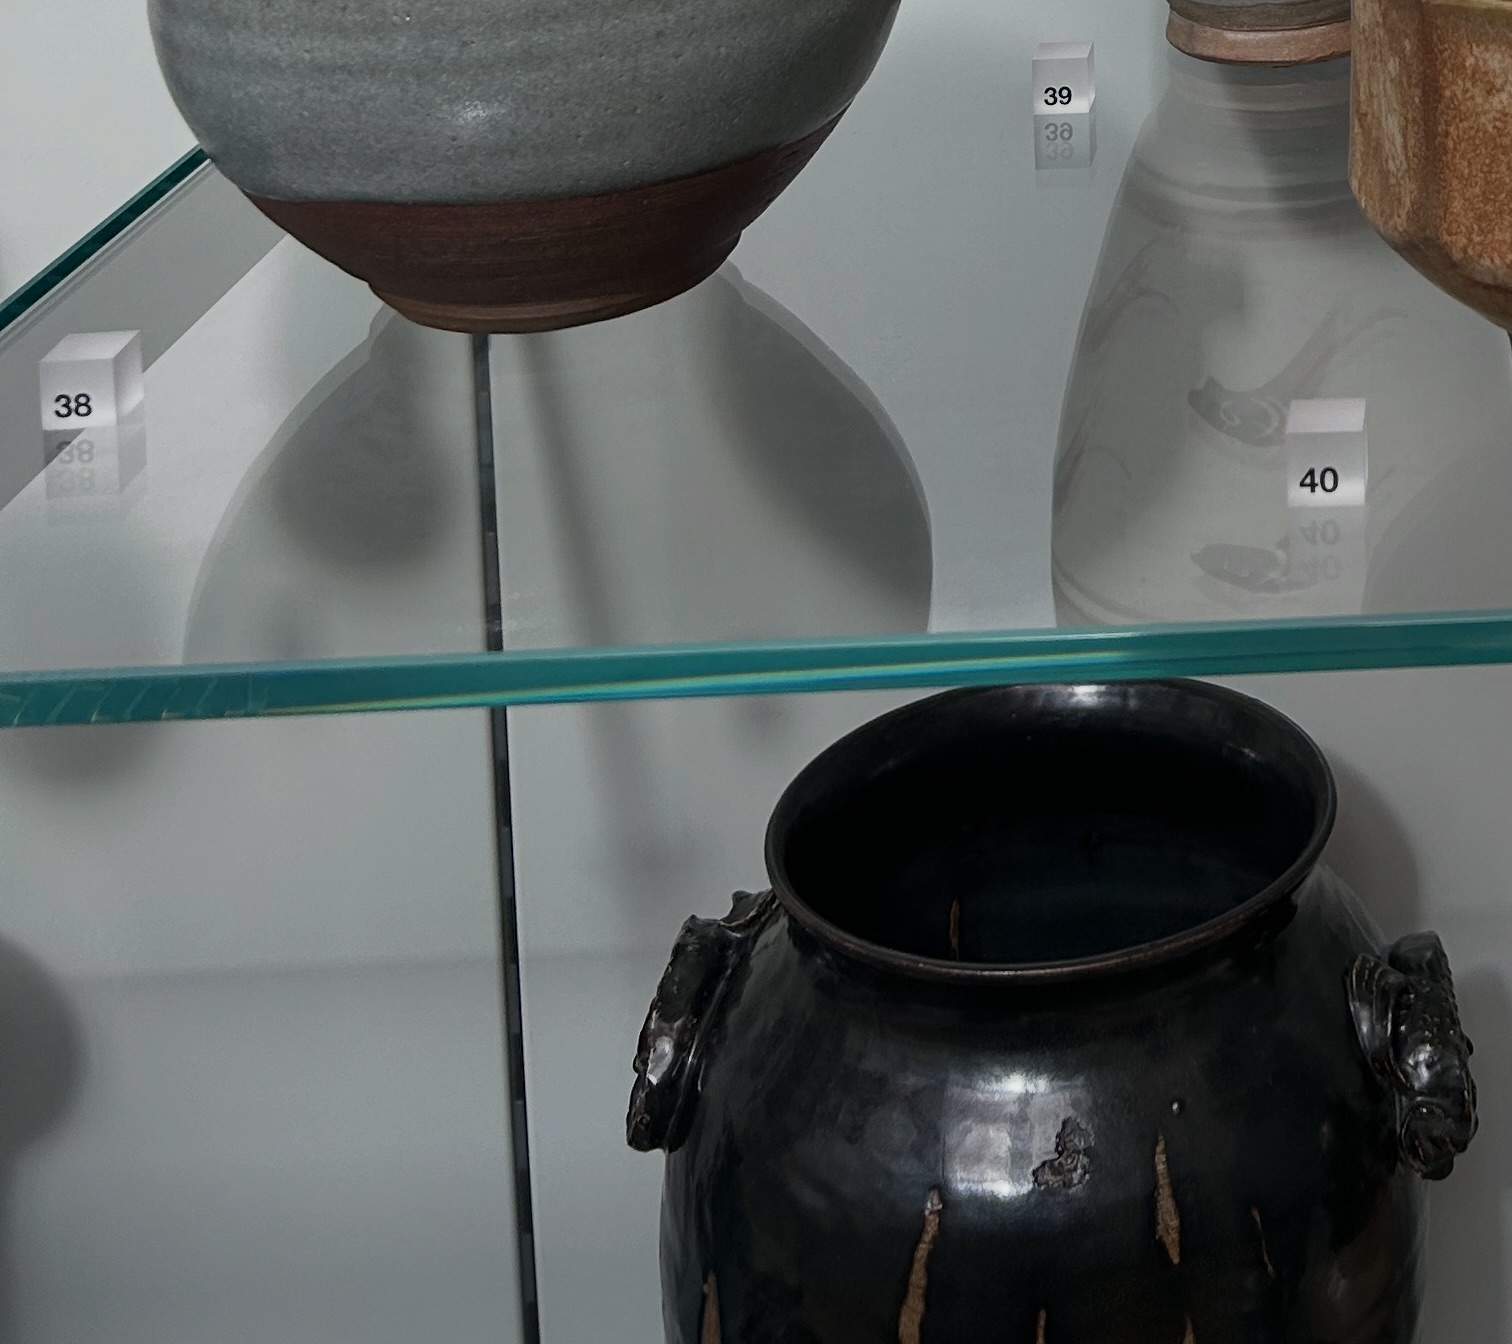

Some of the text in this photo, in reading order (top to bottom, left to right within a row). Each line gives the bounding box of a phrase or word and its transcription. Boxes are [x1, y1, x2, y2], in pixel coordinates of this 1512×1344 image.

[1044, 86, 1072, 106] 39
[54, 393, 93, 418] 38
[1299, 466, 1339, 493] 40
